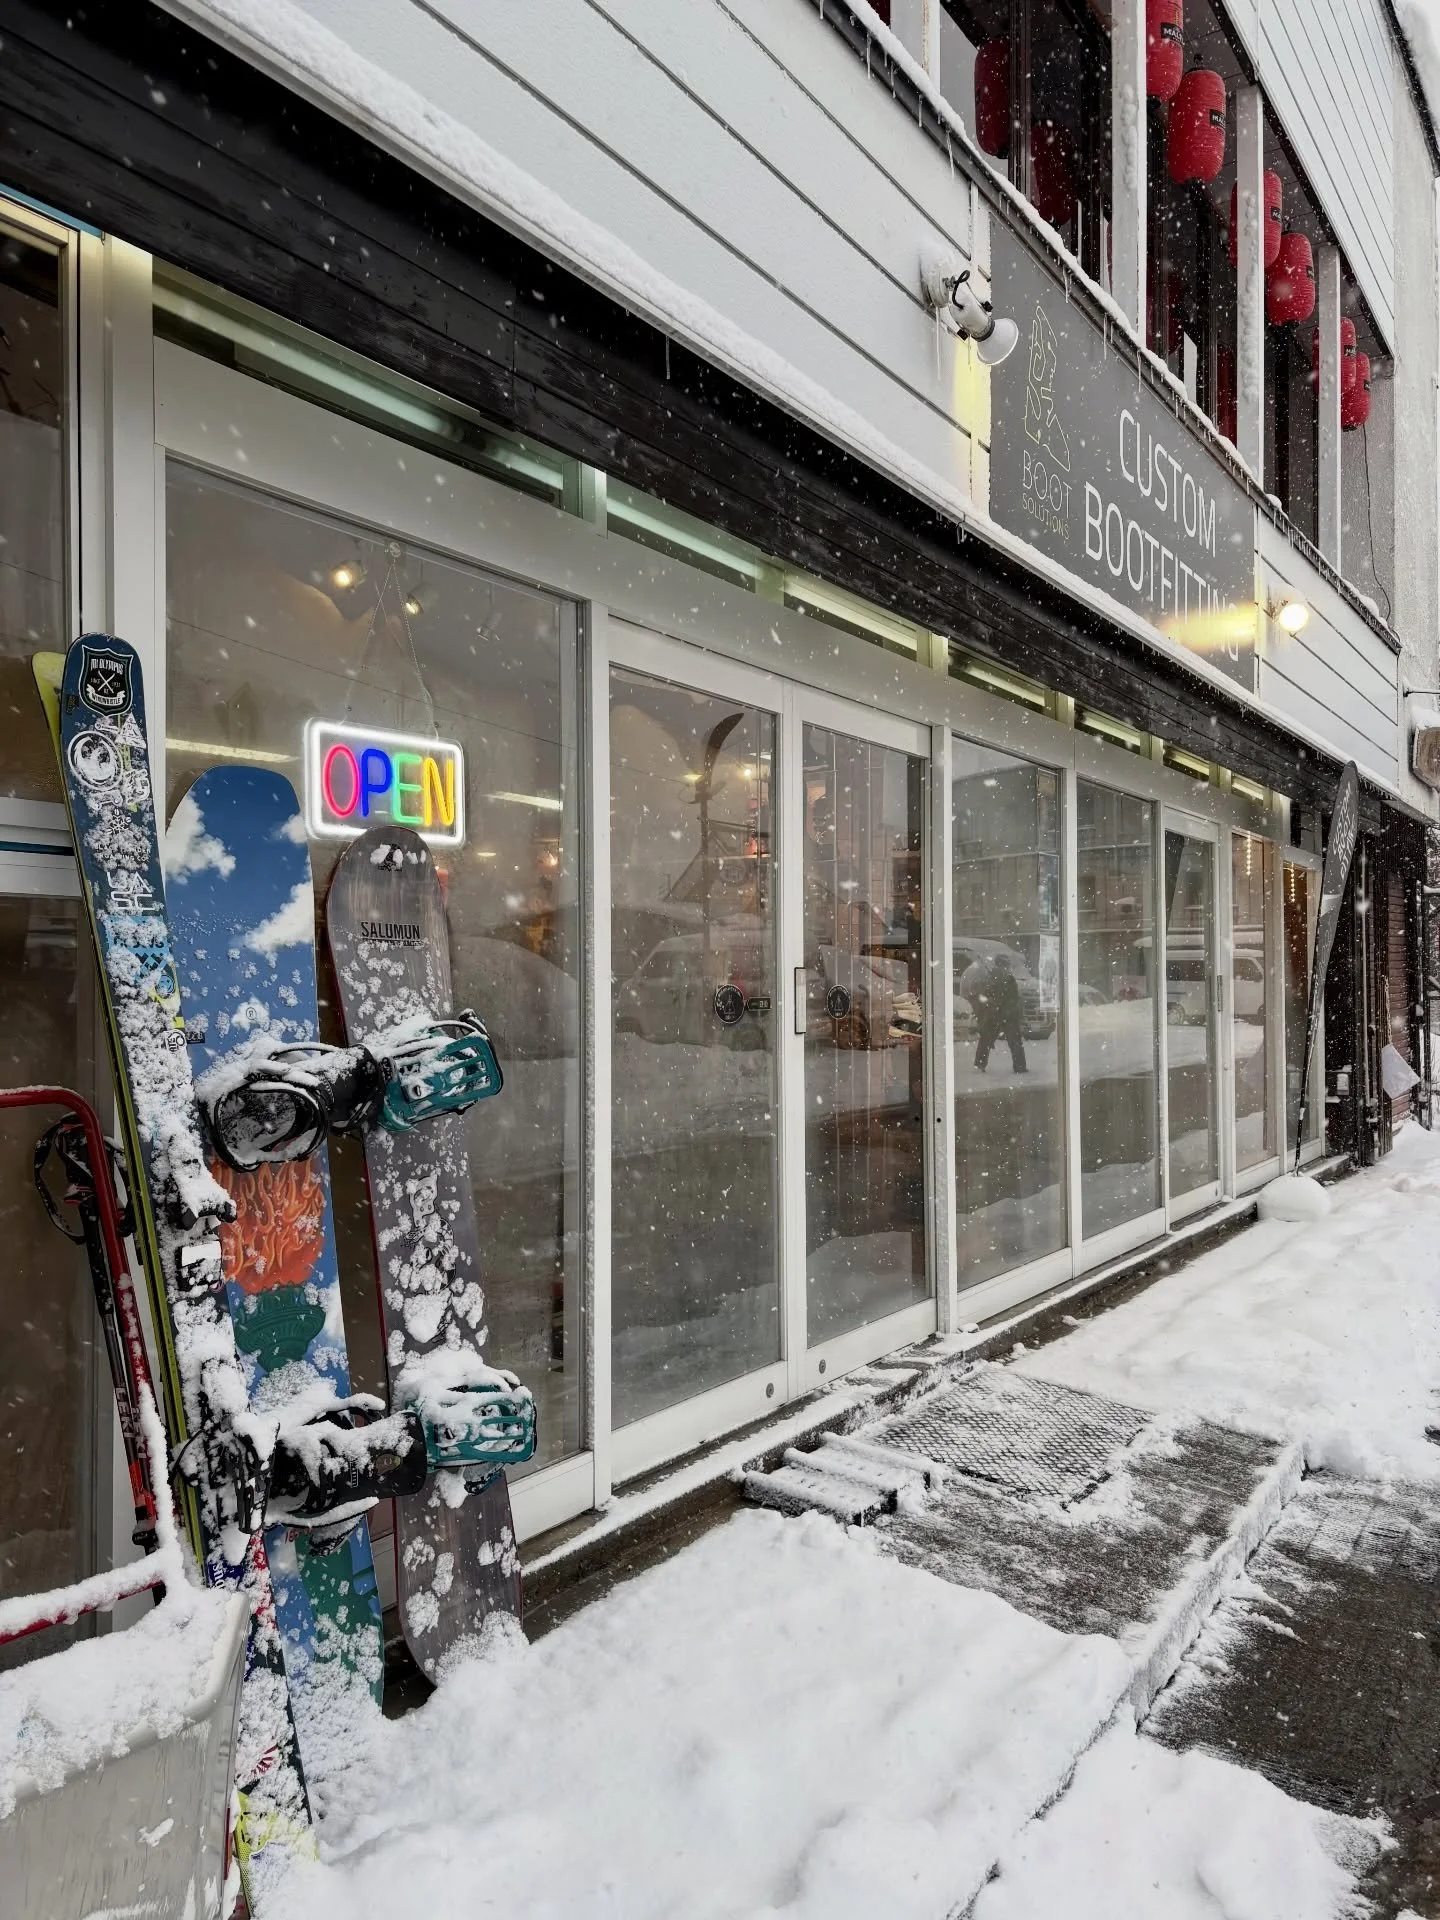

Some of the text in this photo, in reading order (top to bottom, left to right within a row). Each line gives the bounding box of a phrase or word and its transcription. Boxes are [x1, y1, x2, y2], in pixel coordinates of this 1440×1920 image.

[1022, 492, 1070, 540] SOLUTIONS
[1023, 449, 1072, 519] BOOT
[1119, 408, 1216, 558] CUSTOM
[323, 744, 454, 826] OPEN
[115, 1387, 135, 1439] LEKI
